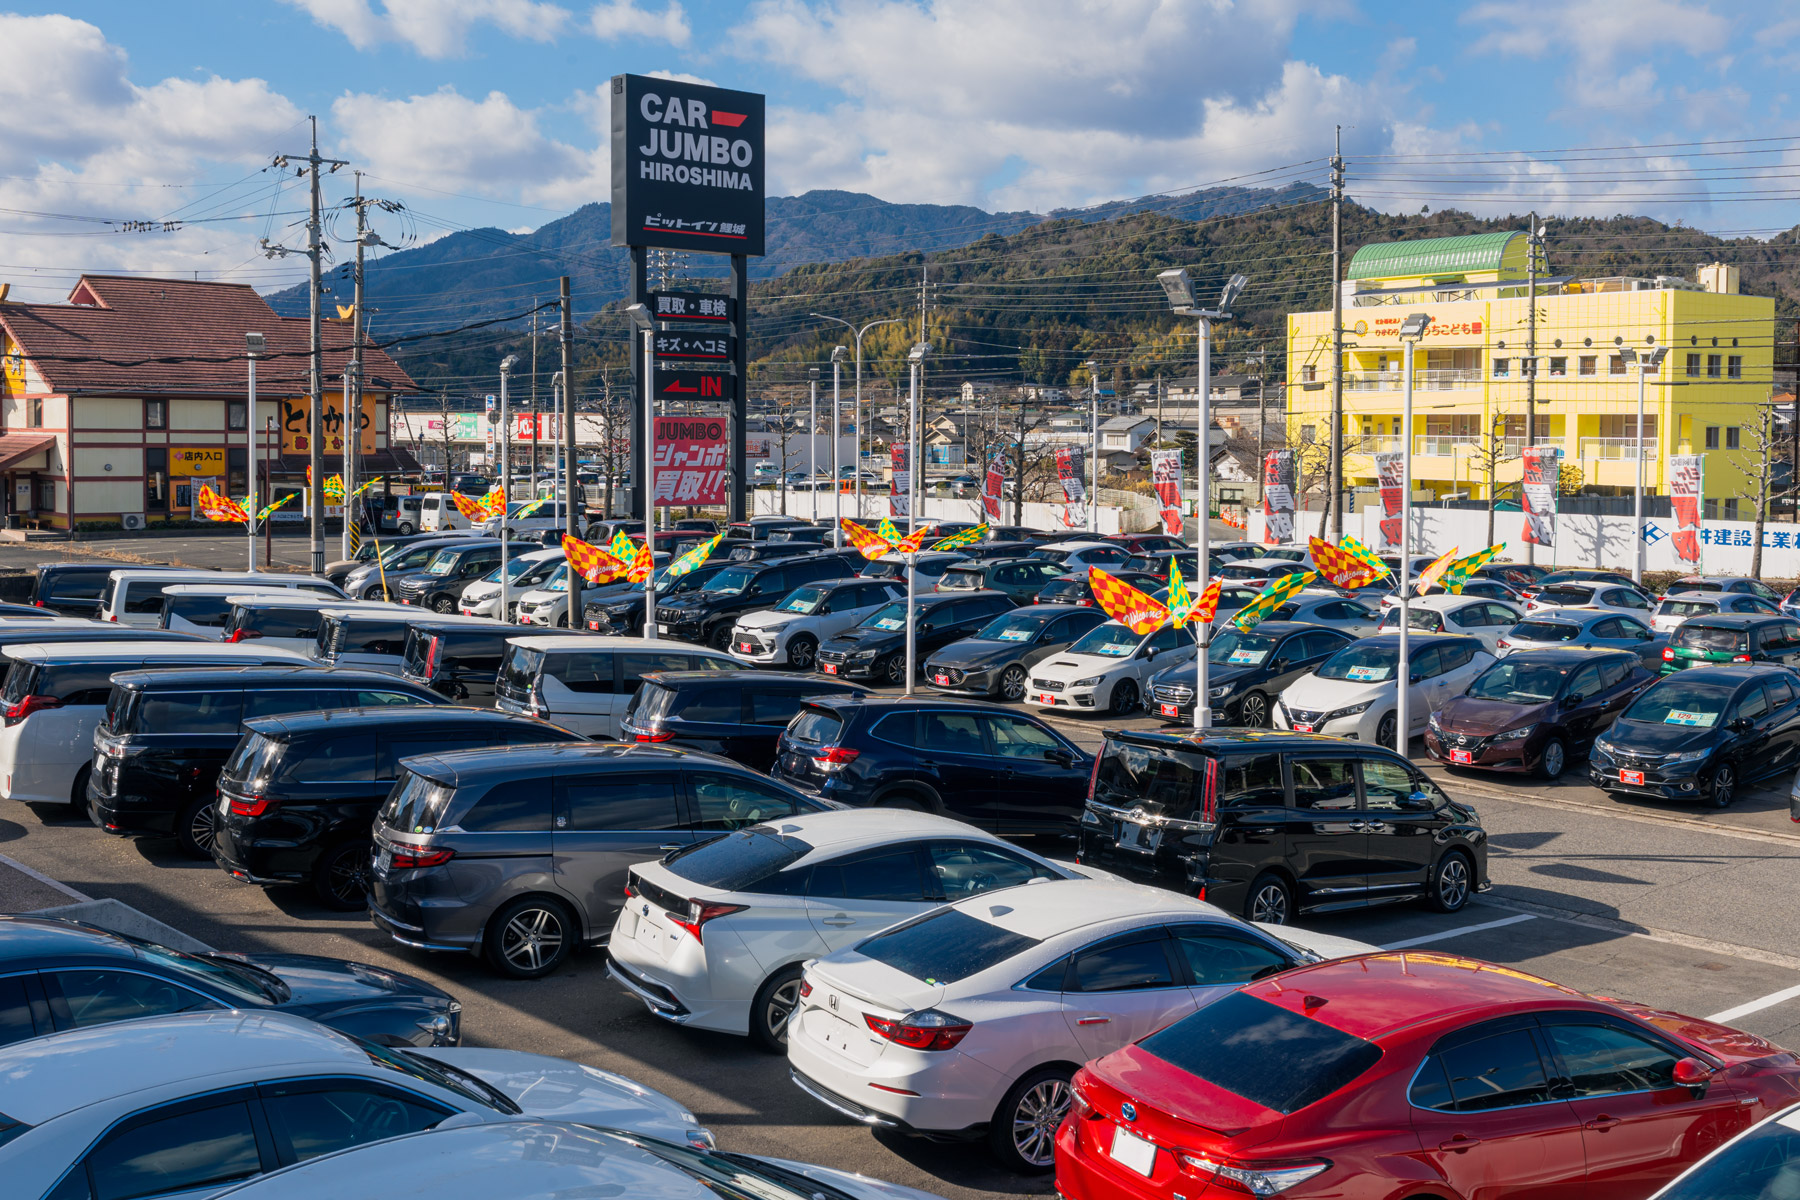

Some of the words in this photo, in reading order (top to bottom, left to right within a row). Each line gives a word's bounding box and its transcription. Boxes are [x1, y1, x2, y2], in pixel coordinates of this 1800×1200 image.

[640, 93, 708, 129] CAR
[639, 128, 753, 168] JUMBO
[641, 161, 753, 191] HIROSHIMA
[657, 296, 726, 316] 買取・車検
[657, 337, 727, 354] キズ・ヘコミ
[701, 376, 722, 396] IN
[657, 422, 722, 440] JUMBO
[184, 452, 222, 461] 店内入口
[654, 443, 727, 467] ジャンボ
[586, 564, 620, 580] Welcome
[1333, 569, 1370, 586] Welcome
[1123, 608, 1162, 628] Welcome
